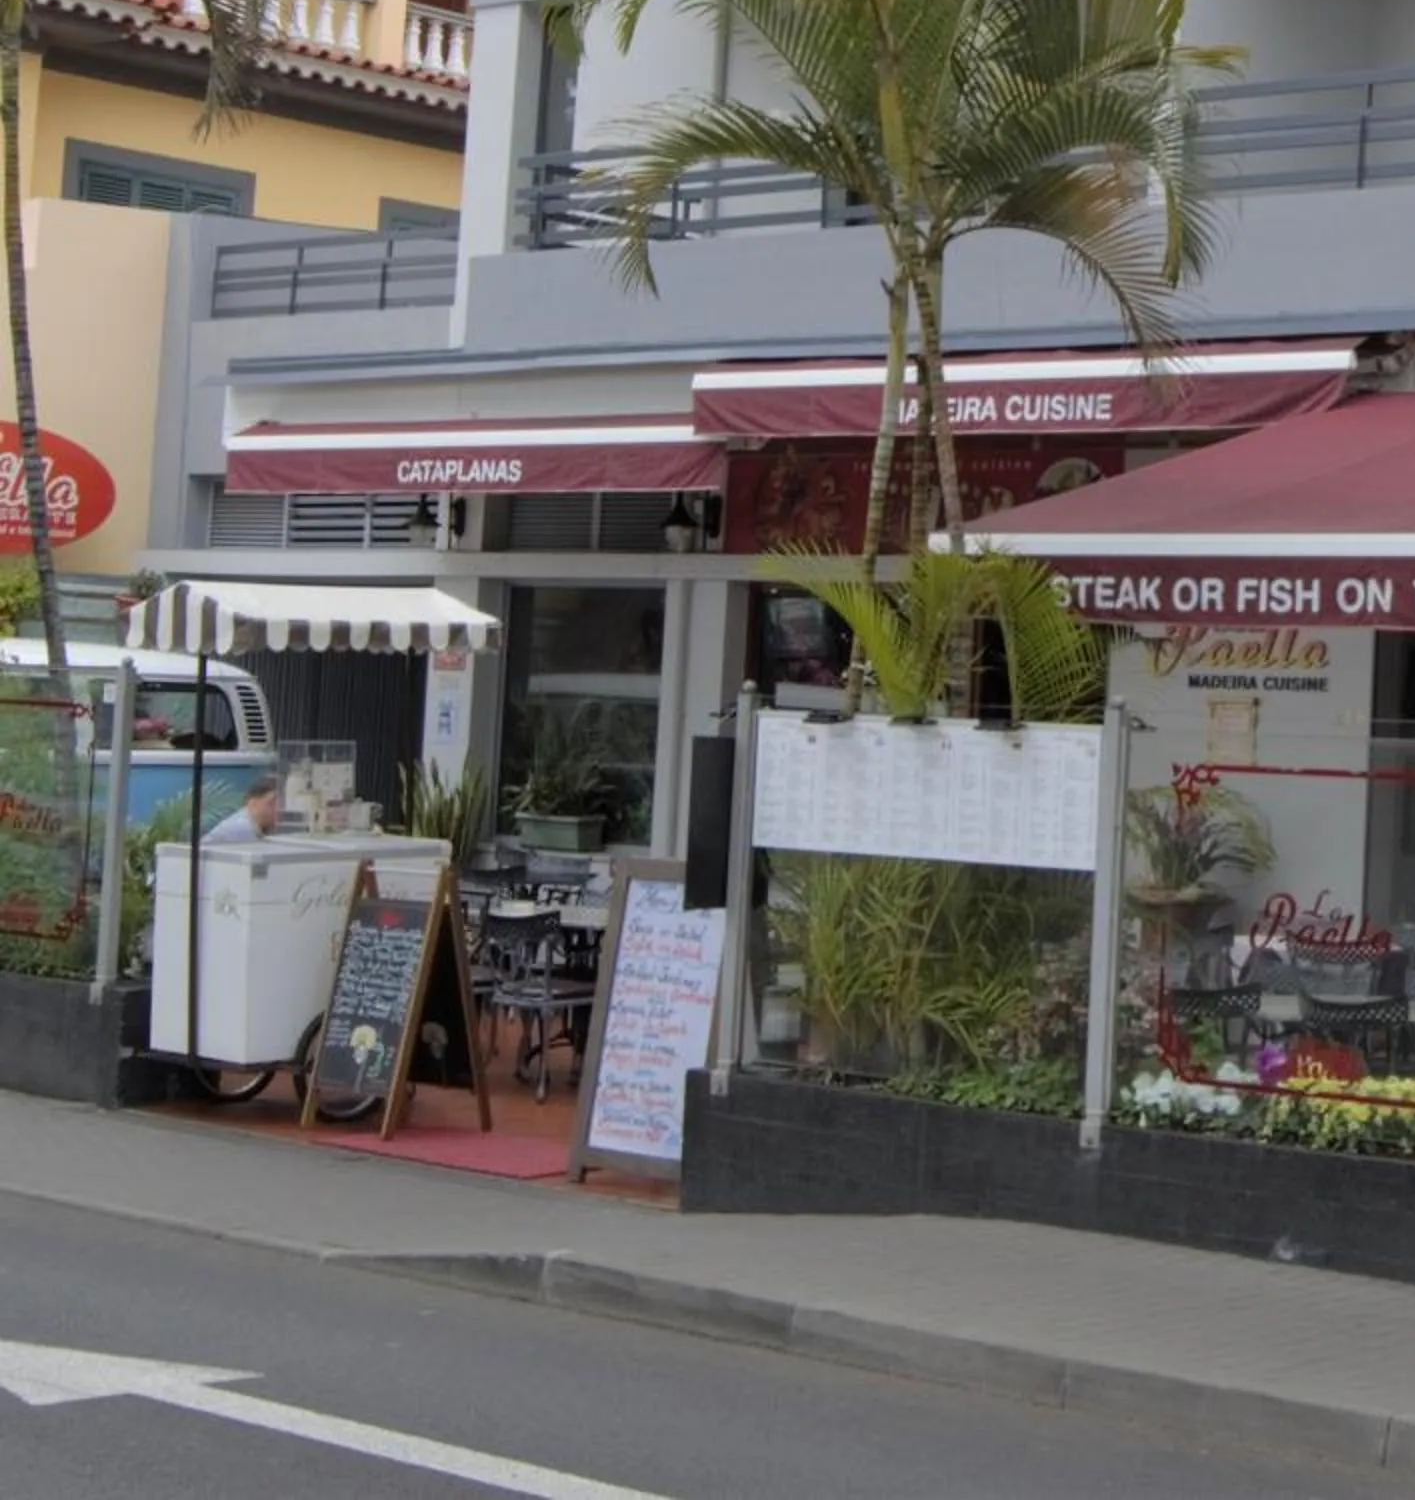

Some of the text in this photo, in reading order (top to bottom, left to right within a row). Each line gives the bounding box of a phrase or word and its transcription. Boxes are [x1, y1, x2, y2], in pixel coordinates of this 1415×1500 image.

[1004, 393, 1113, 422] CUISINE
[396, 459, 523, 484] CATAPLANAS
[1052, 575, 1162, 611] STEAK
[1172, 576, 1225, 613] OR
[1236, 577, 1322, 614] FISH
[1335, 578, 1394, 615] ON
[1188, 674, 1329, 692] MADEIRA CUISINE
[1302, 888, 1344, 922] La
[1250, 892, 1394, 956] Paella
